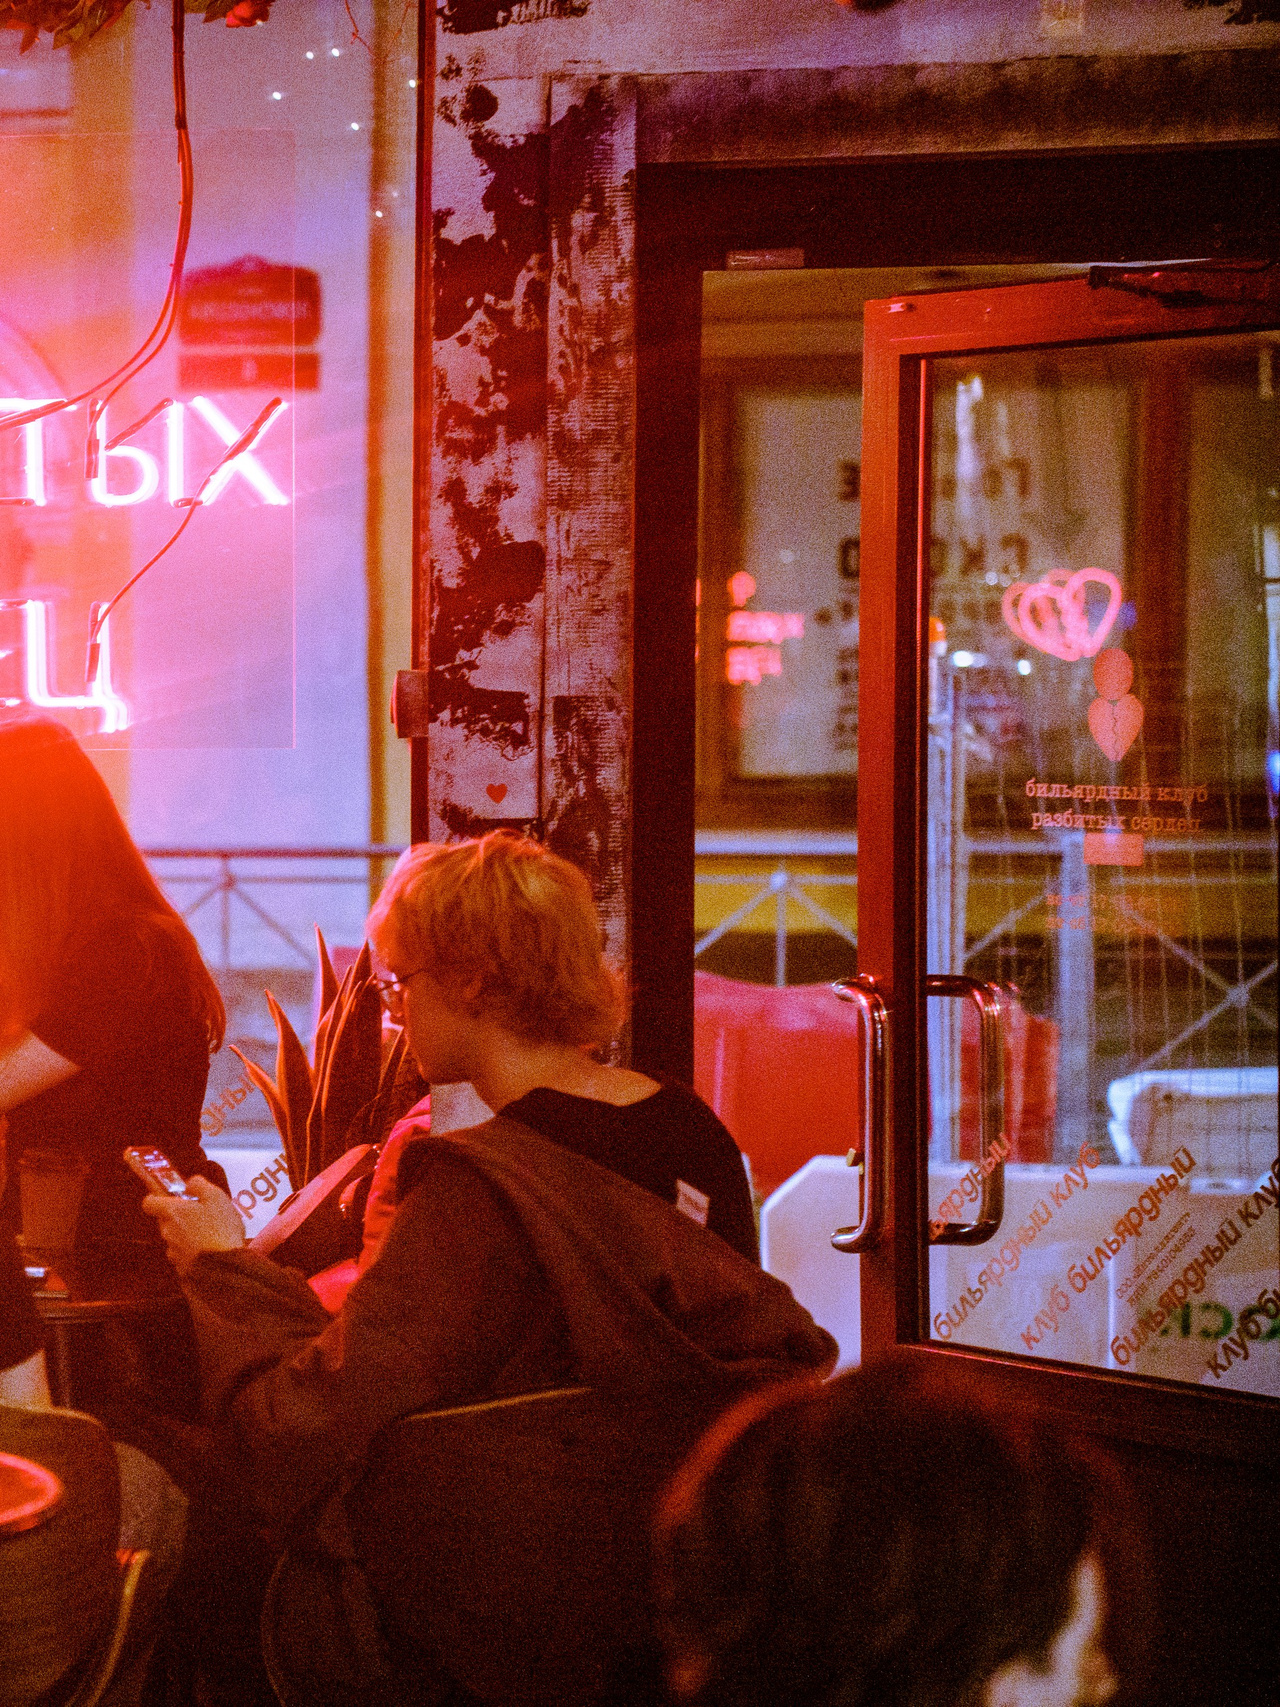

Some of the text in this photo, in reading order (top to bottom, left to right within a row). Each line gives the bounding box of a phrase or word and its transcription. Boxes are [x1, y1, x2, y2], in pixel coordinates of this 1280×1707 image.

[1025, 777, 1209, 806] бильярдный клуб
[1031, 808, 1125, 830] разбитых
[934, 1141, 1101, 1340] бильярдный клуб
[1020, 1284, 1070, 1350] клуб
[1067, 1145, 1196, 1294] бильярдный
[1110, 1217, 1242, 1366] бильярдный
[1206, 1304, 1262, 1379] клуб
